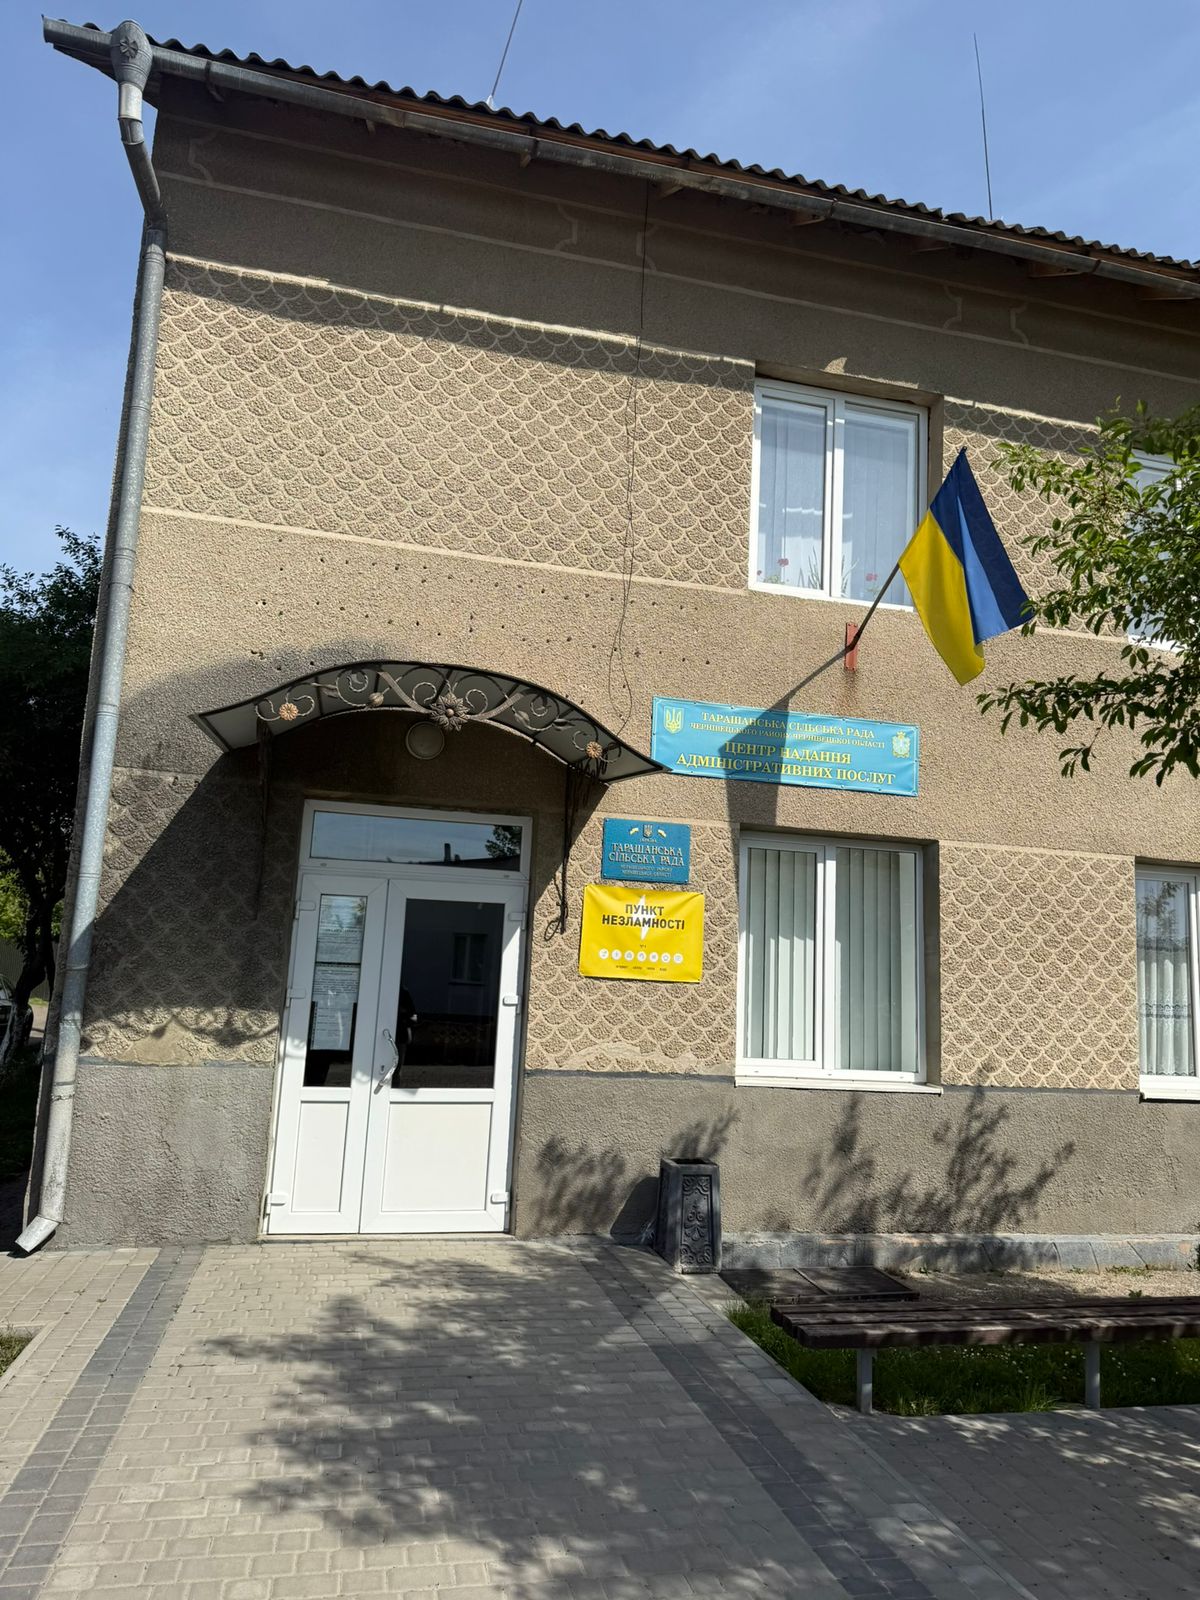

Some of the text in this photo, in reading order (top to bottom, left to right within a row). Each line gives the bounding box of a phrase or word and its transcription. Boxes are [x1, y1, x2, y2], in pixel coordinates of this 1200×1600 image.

[702, 711, 875, 739] ТАРАШАНСЬКА СІЛЬСЬКА РАДА
[725, 741, 851, 764] ЦЕНТР НАДАННЯ
[677, 752, 896, 785] АДМІНІСТРАТИВНИХ ПОСЛУГ
[611, 842, 683, 857] ТАРАШАНСЬКА
[608, 851, 685, 867] СІЛЬСЬКА РАДА
[625, 904, 665, 916] ПУНКТ
[602, 914, 685, 930] НЕЗЛАМНОСТІ
